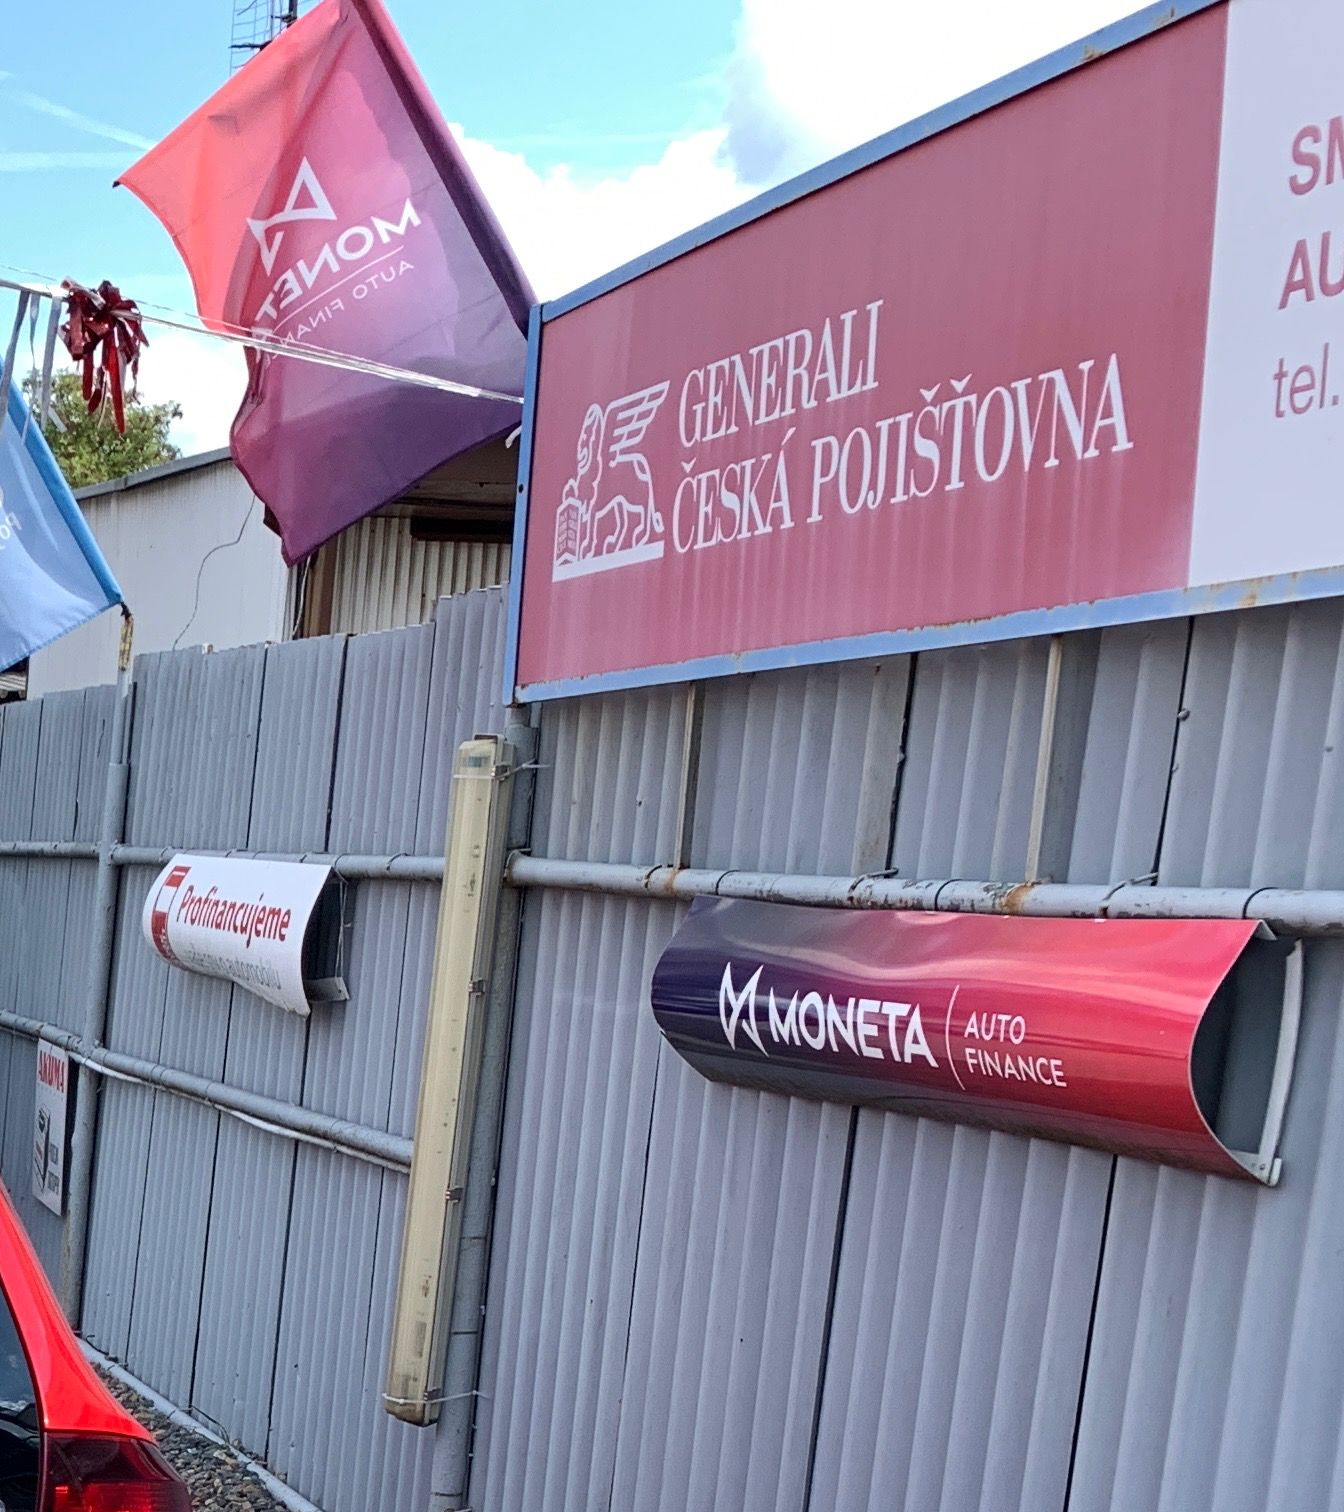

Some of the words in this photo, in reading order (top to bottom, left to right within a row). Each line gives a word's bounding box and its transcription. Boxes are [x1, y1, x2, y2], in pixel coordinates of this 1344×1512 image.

[678, 298, 885, 449] GENERALI
[1272, 342, 1341, 418] tel.
[672, 426, 795, 555] ČESKÁ
[806, 352, 1134, 525] POJIŠŤOVNA
[176, 884, 292, 949] Profinancujeme
[768, 985, 939, 1068] MONETA
[964, 1012, 1026, 1046] AUTO
[965, 1047, 1068, 1088] FINANCE
